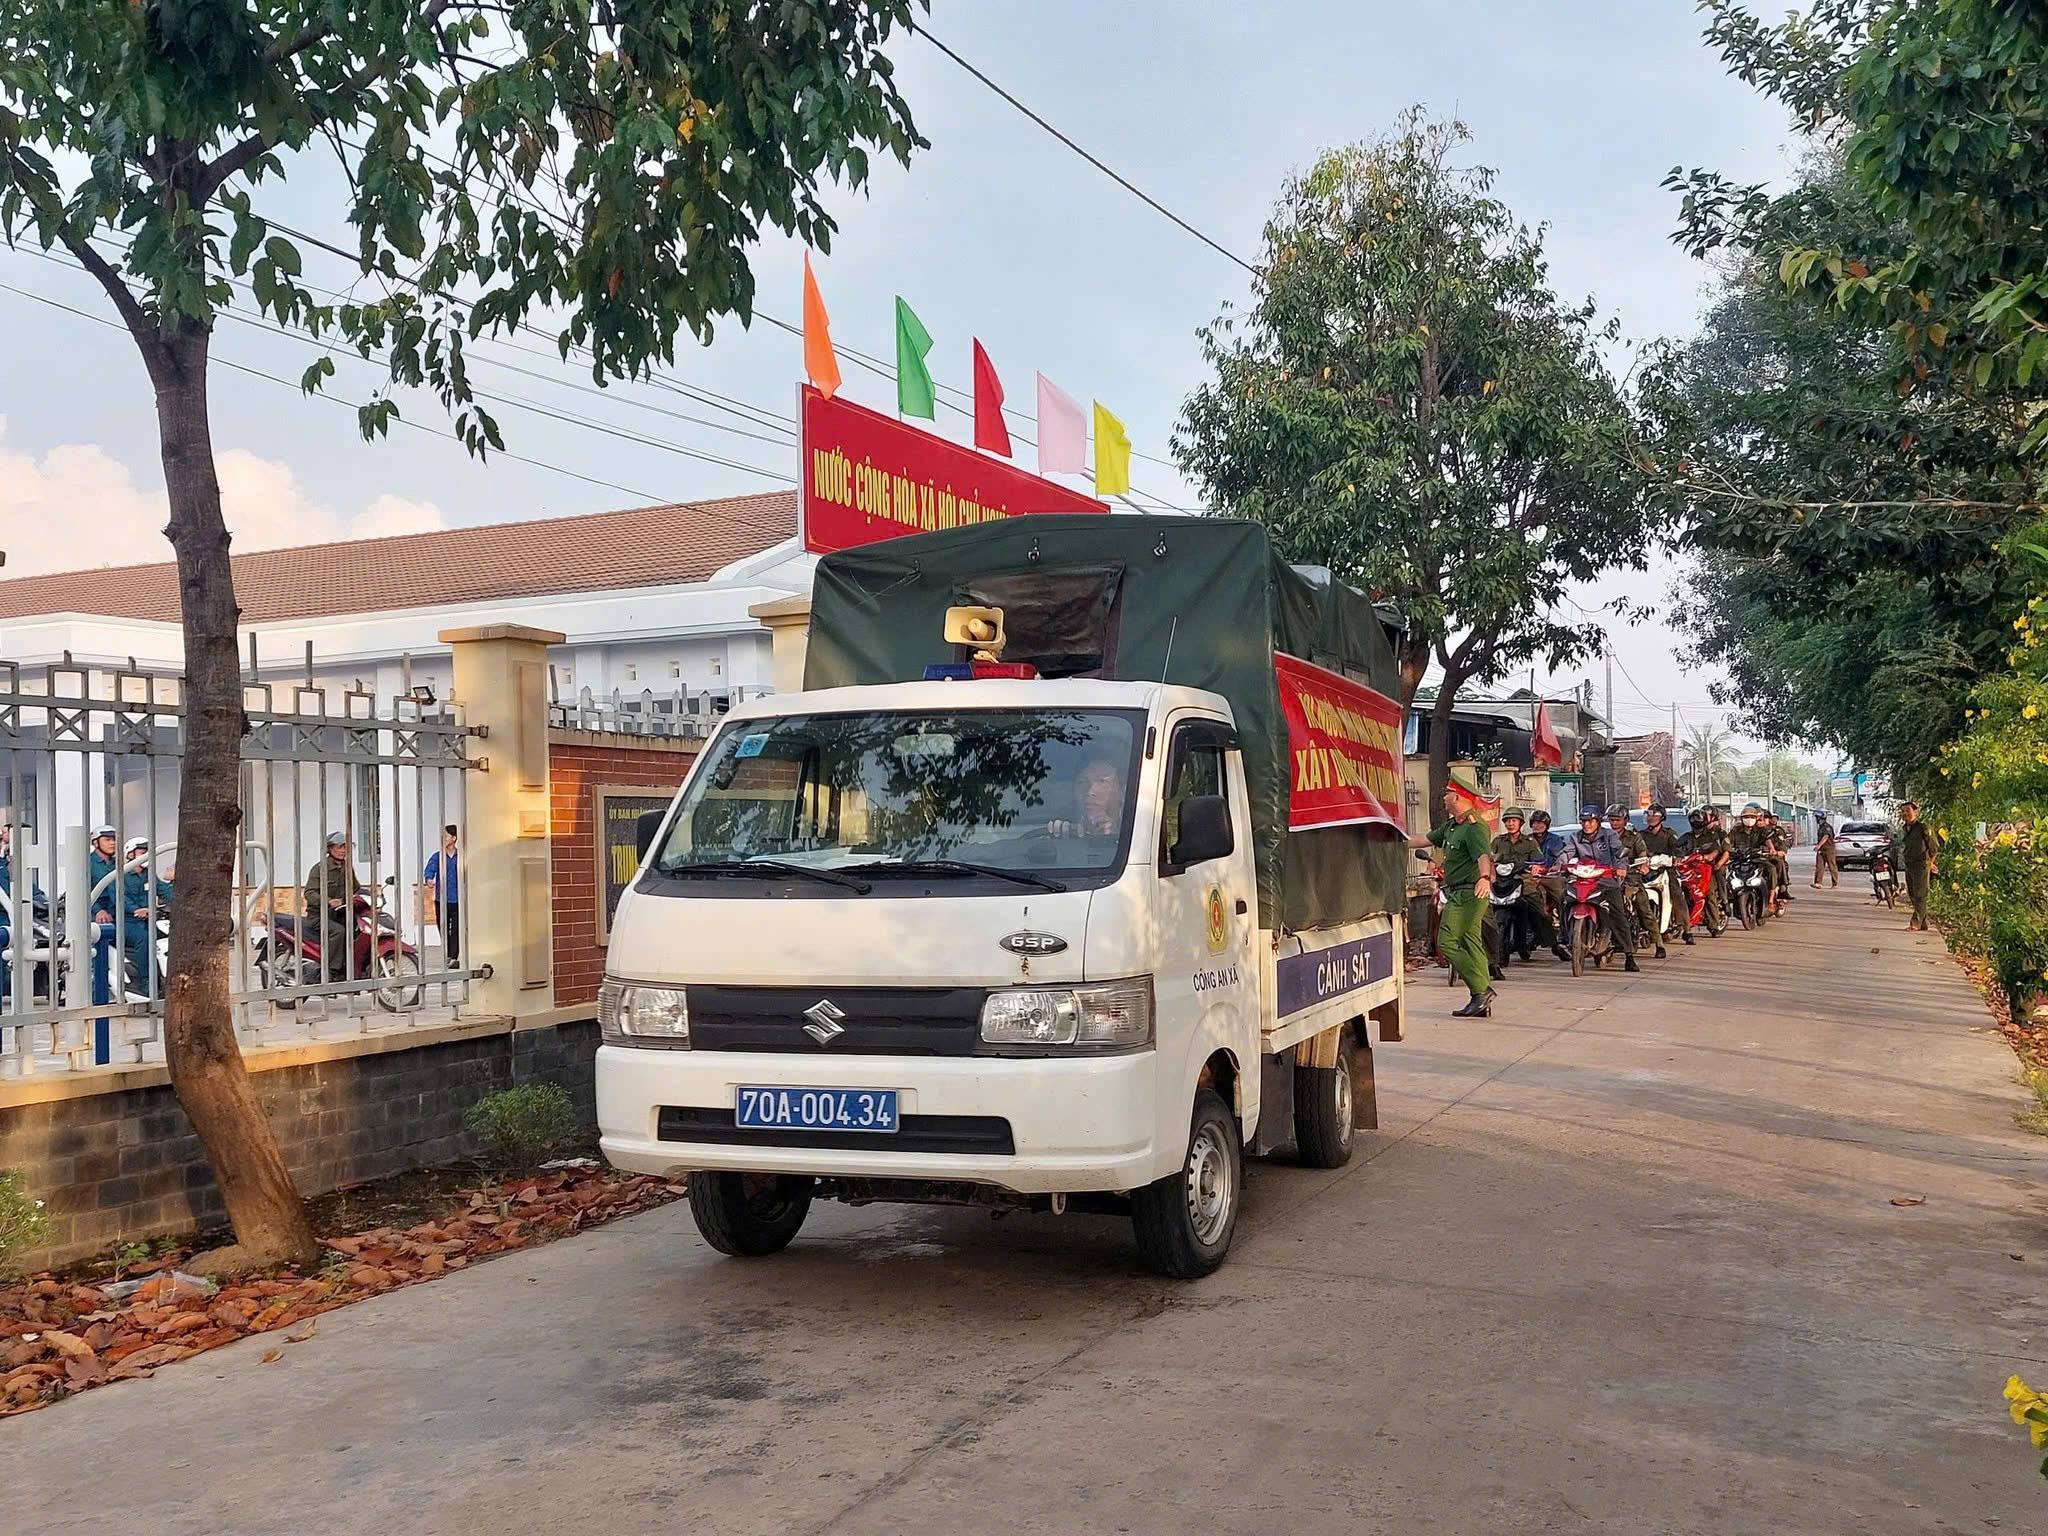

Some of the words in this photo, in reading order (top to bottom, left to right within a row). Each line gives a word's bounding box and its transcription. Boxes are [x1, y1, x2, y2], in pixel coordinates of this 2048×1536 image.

[814, 445, 852, 507] NƯỚC
[856, 455, 890, 524] CỘNG
[893, 467, 917, 527] HÒA
[920, 478, 935, 531] XÃ
[1296, 740, 1330, 791] XÂY
[1011, 936, 1056, 950] GSP
[1217, 969, 1228, 987] AN
[1317, 950, 1347, 996] CẢNH
[1352, 943, 1371, 985] SÁT
[742, 1090, 892, 1127] 70A-004.34
